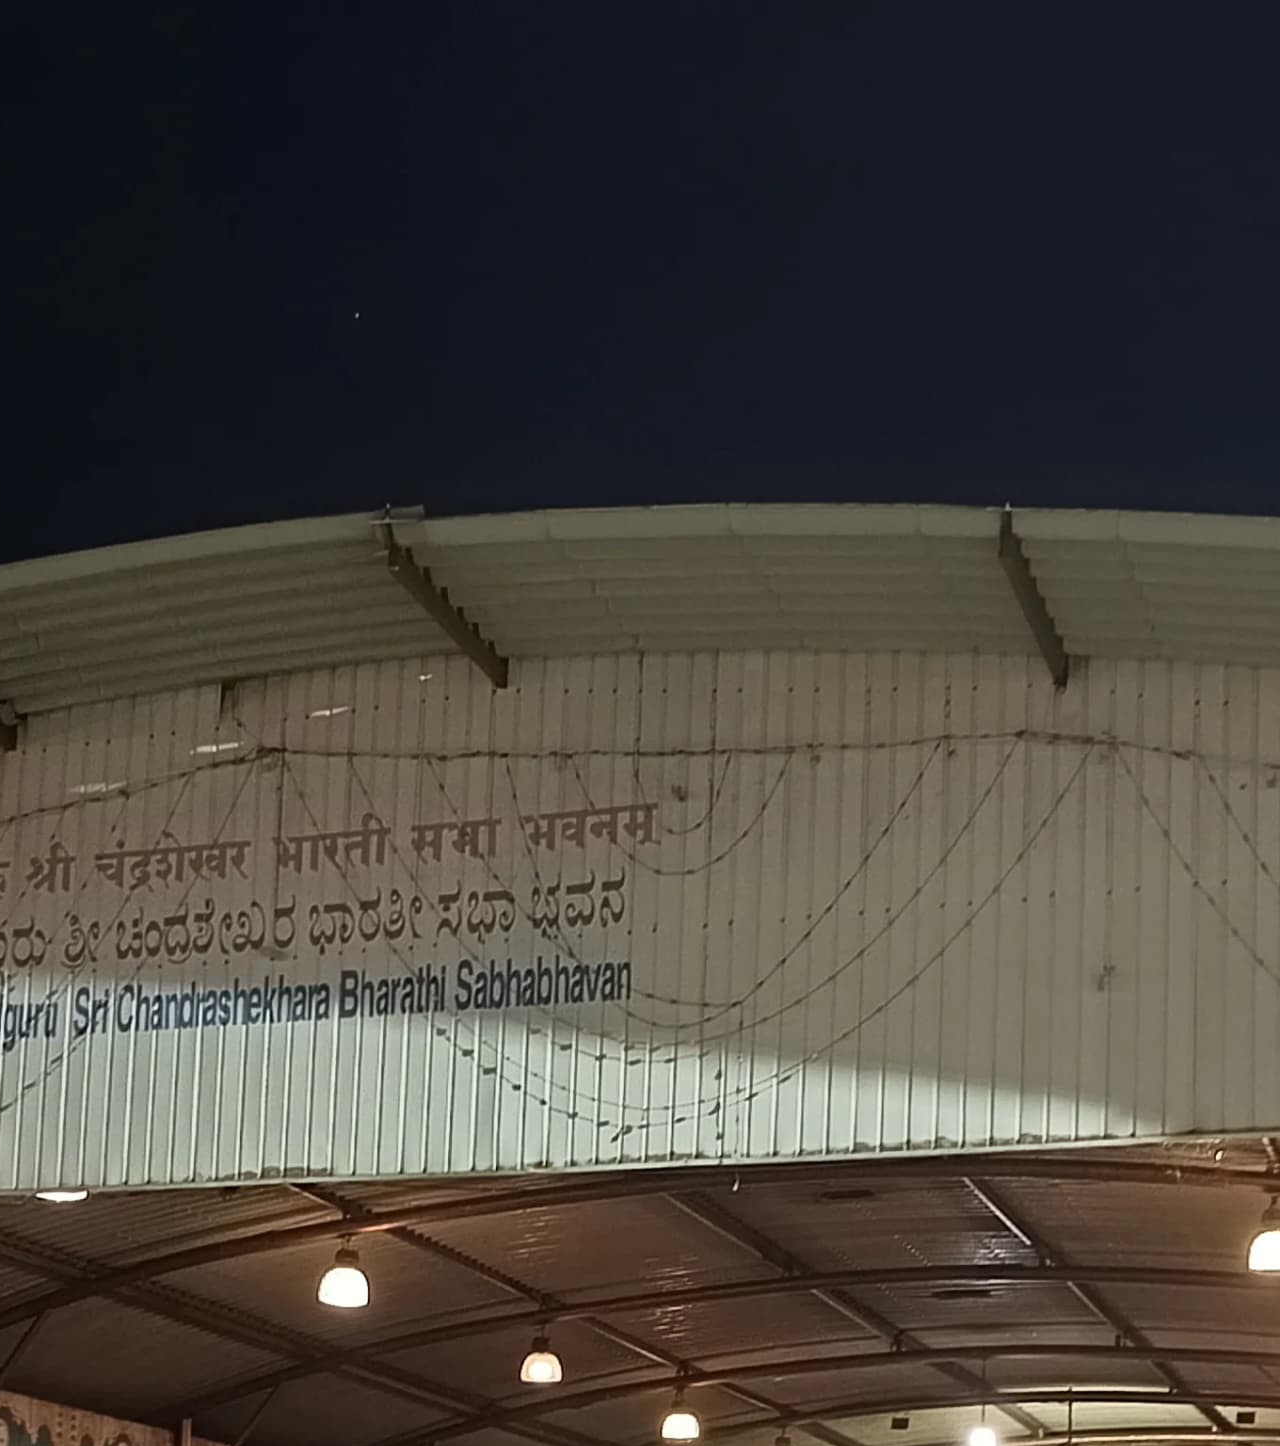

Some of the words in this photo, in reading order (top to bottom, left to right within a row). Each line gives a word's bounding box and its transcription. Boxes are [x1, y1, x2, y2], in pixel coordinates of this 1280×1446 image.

[26, 840, 76, 893] श्री
[272, 812, 391, 874] भारती
[411, 818, 502, 864] सभा
[521, 802, 662, 851] भवनम्
[436, 879, 516, 944] ಸಭಾ
[73, 985, 109, 1036] Sri
[119, 974, 330, 1033] Chandrashekhara
[339, 966, 446, 1018] Bharathi
[454, 956, 632, 1011] Sabhabhavan
